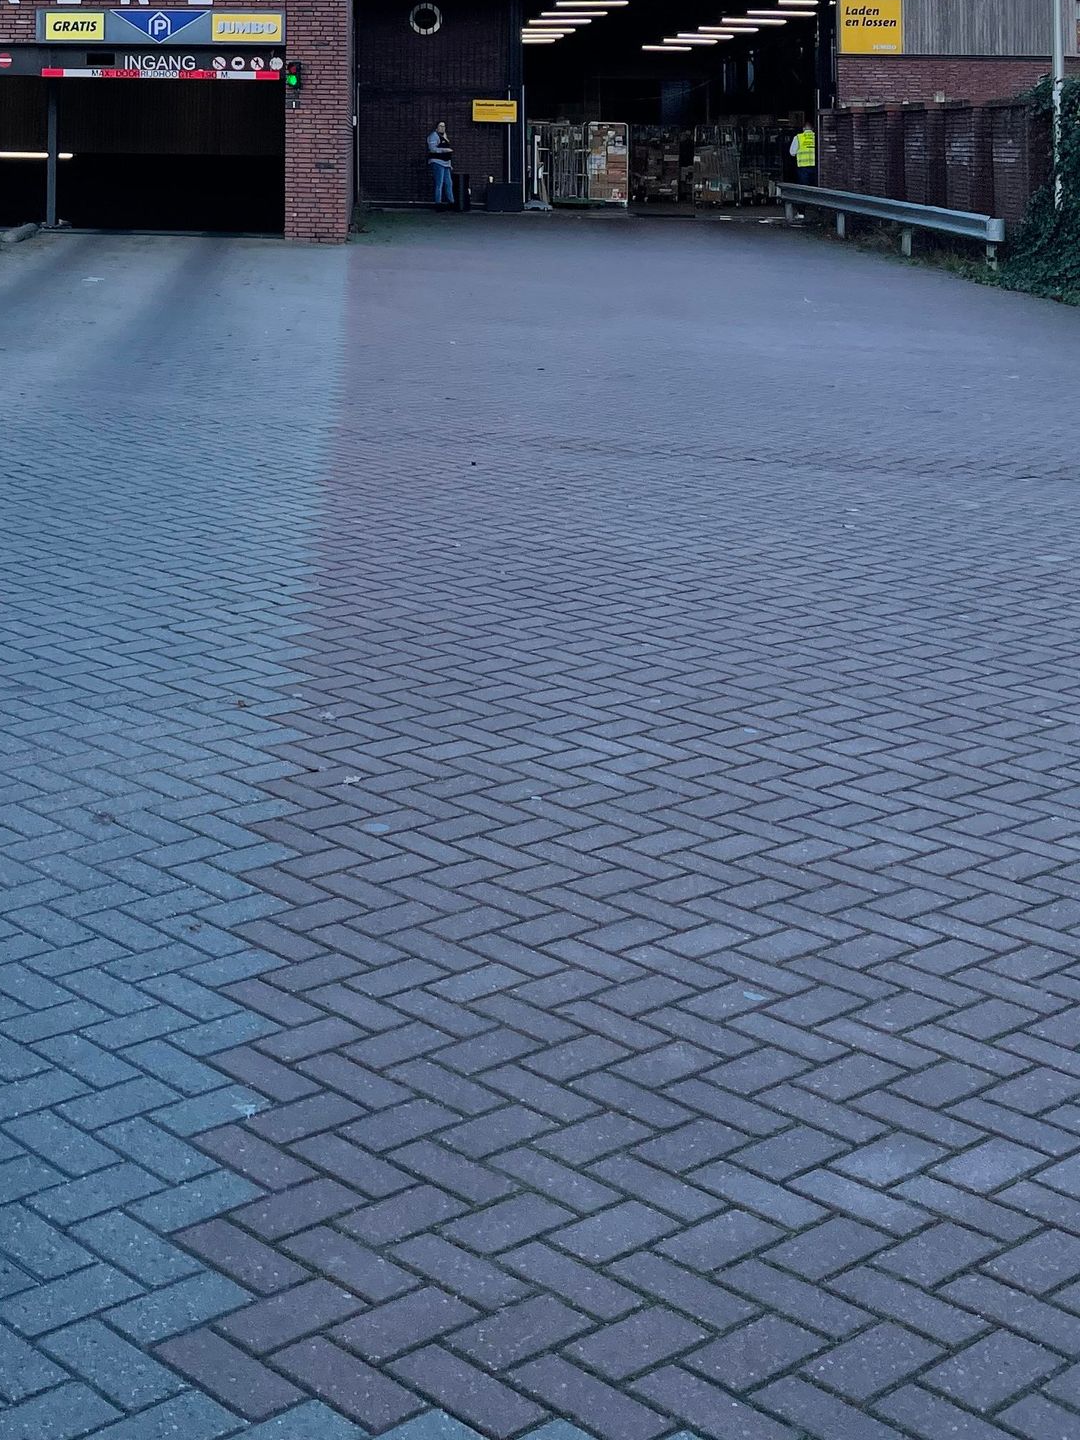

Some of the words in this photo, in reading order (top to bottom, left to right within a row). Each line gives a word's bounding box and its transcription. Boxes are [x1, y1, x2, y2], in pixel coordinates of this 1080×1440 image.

[846, 6, 880, 16] Laden
[53, 21, 97, 32] GRATIS
[217, 20, 278, 34] JUMBO
[845, 19, 859, 27] en
[862, 16, 897, 27] lossen
[124, 55, 196, 71] INGANG
